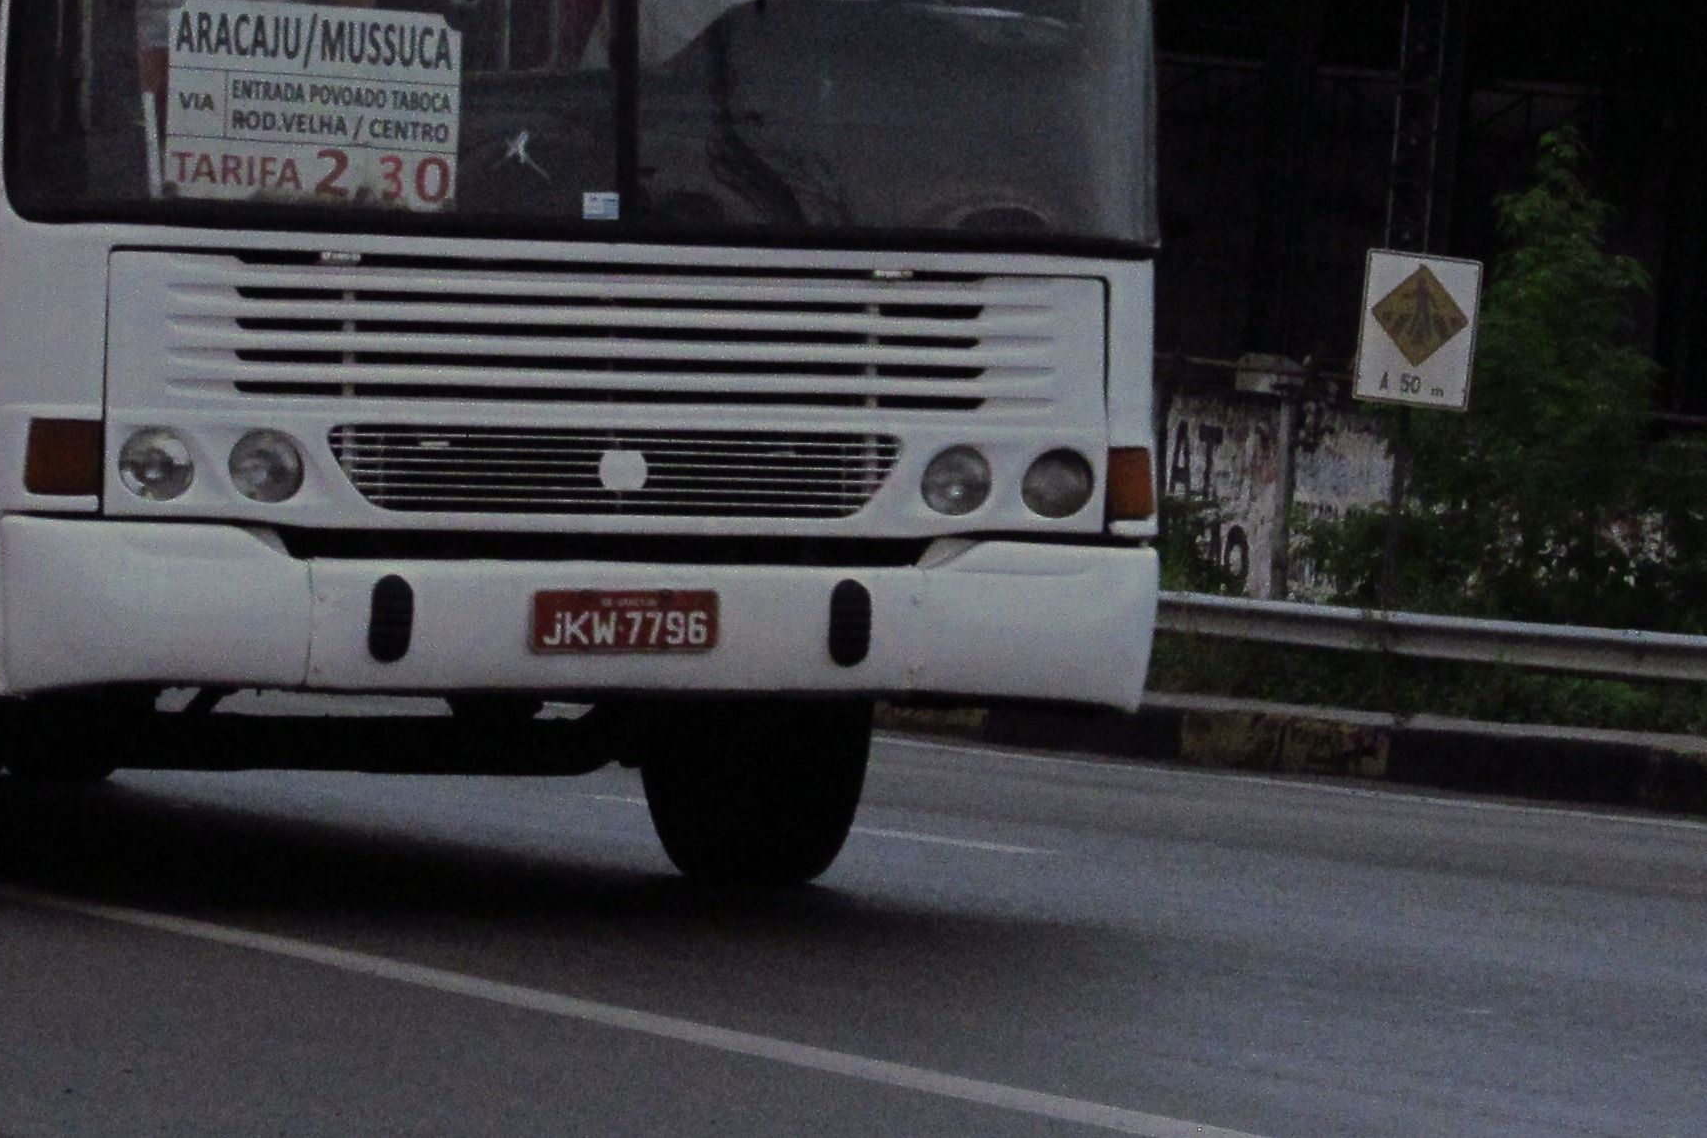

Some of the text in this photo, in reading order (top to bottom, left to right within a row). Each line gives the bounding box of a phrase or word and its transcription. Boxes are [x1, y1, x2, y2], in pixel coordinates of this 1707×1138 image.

[176, 11, 453, 70] ARACAJU/MUSSUCA
[179, 92, 214, 112] VIA
[232, 79, 452, 113] ENTRADA POVOADO TABOCA
[368, 118, 450, 145] CENTRO
[173, 152, 301, 190] TARIFA
[1400, 374, 1421, 394] 50
[1431, 387, 1444, 397] m
